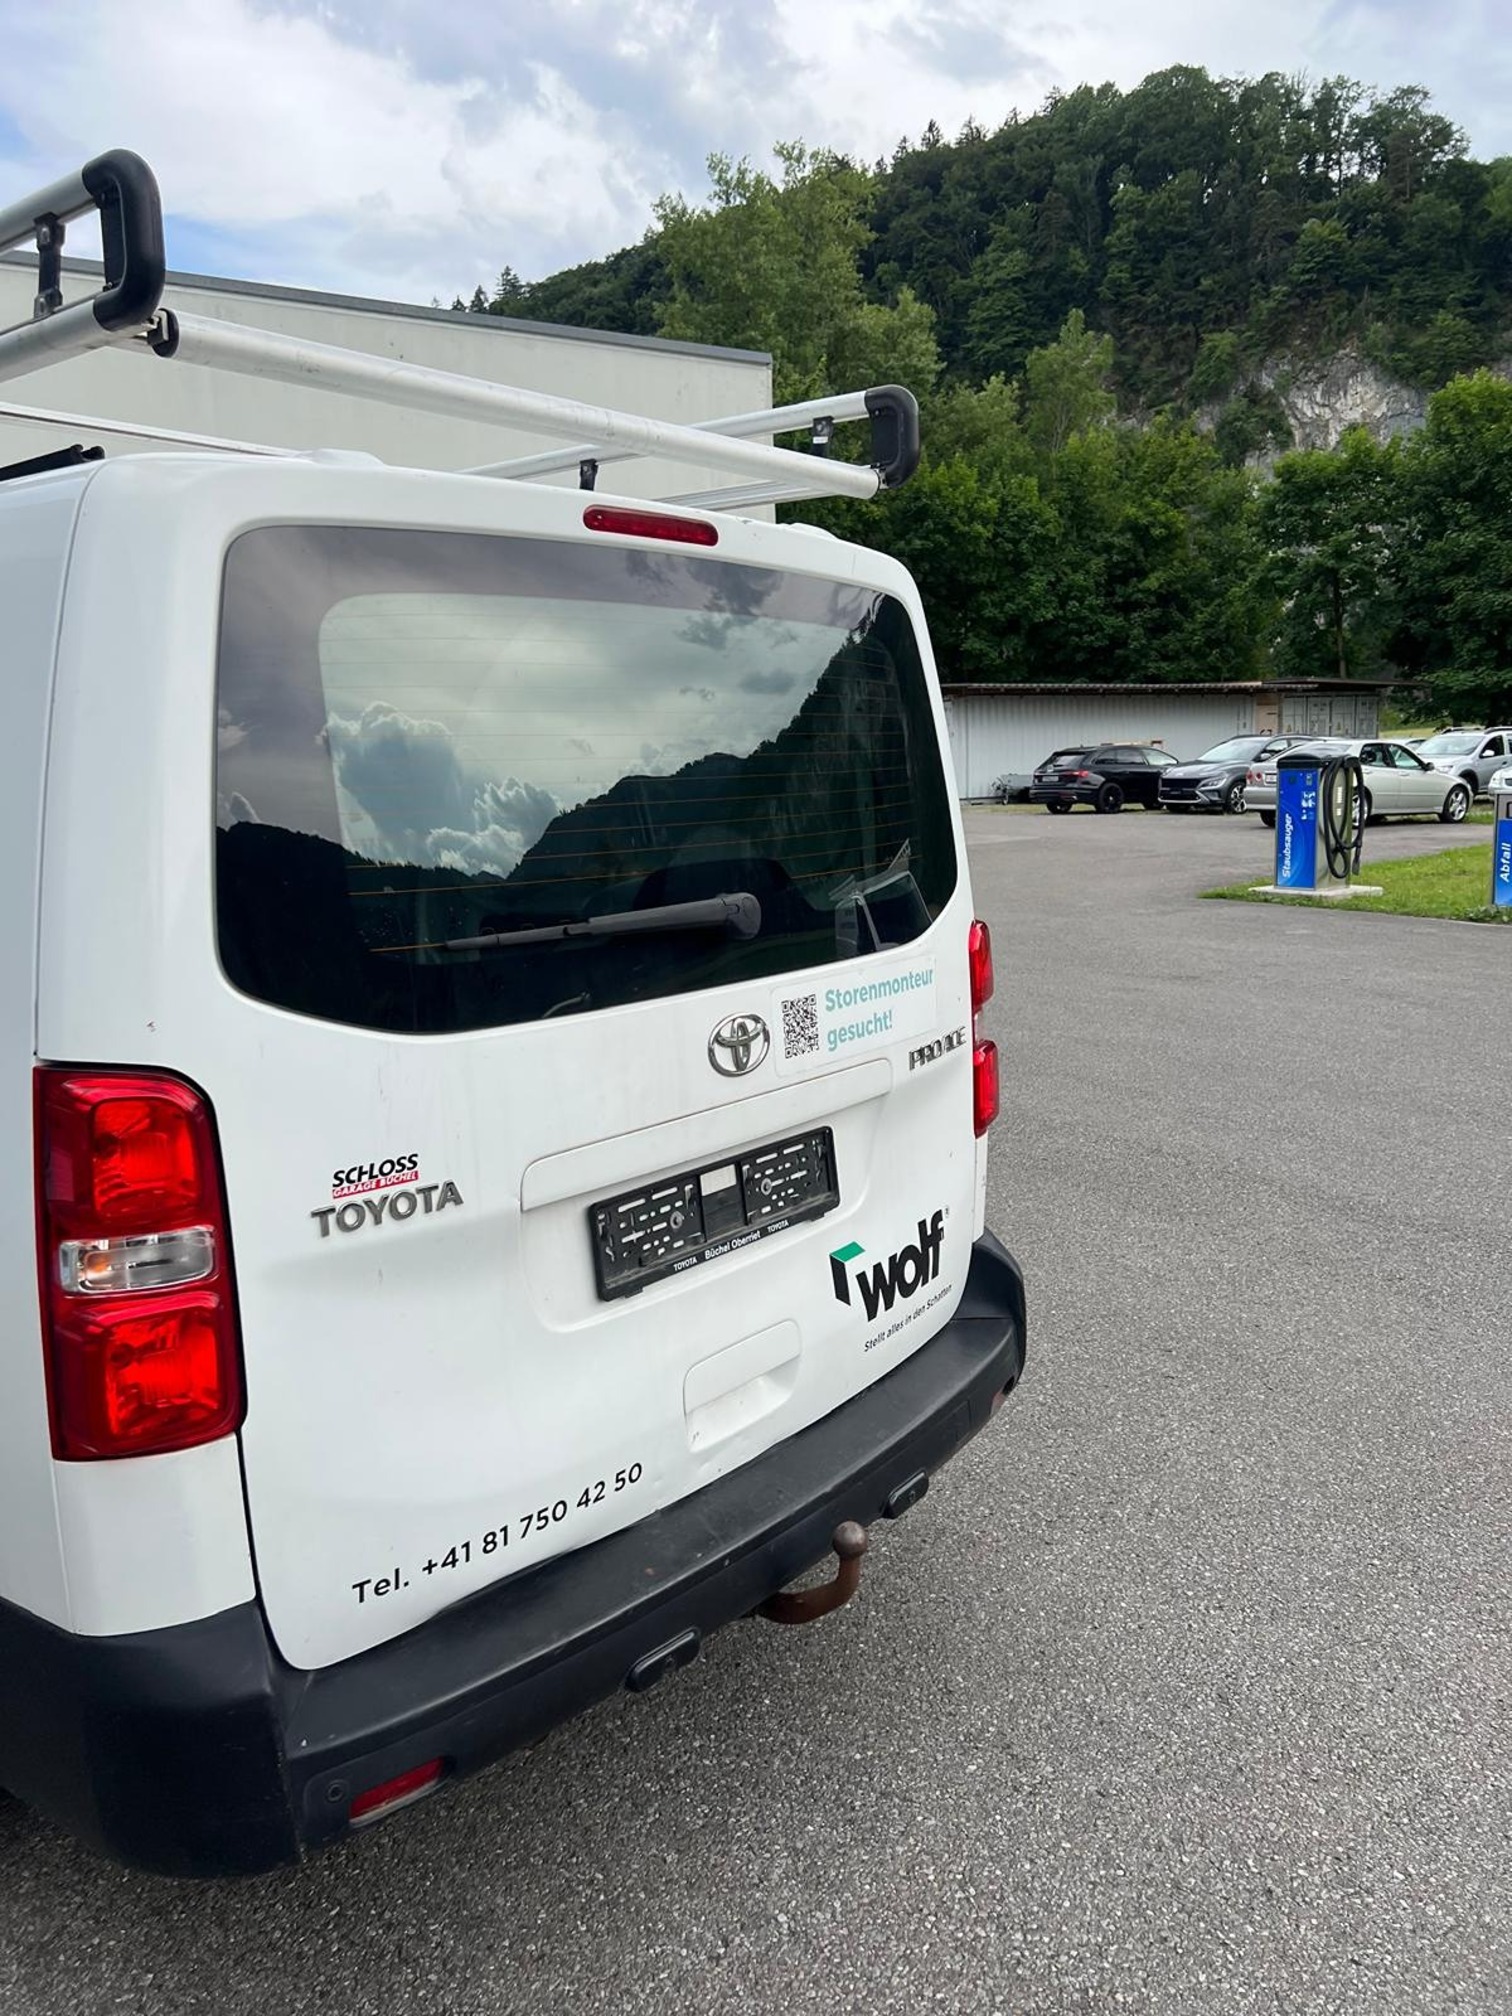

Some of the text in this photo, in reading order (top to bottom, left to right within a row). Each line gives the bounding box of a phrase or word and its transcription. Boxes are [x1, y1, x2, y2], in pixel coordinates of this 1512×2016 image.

[1282, 813, 1295, 878] Staubsauger
[1500, 842, 1512, 883] Abfall
[824, 968, 934, 1013] Storenmonteur
[827, 1010, 893, 1051] gesucht!
[332, 1153, 418, 1187] SCHLOSS
[333, 1180, 377, 1198] GARAGE
[310, 1179, 464, 1238] TOYOTA
[673, 1219, 789, 1271] TOYOTA Büchel Oberriet TOYOTA
[855, 1209, 945, 1322] wolf
[864, 1331, 886, 1352] Stellt
[886, 1320, 904, 1338] alles
[904, 1314, 912, 1325] in
[913, 1305, 926, 1320] den
[351, 1462, 643, 1604] Tel. +41 81 750 42 50
